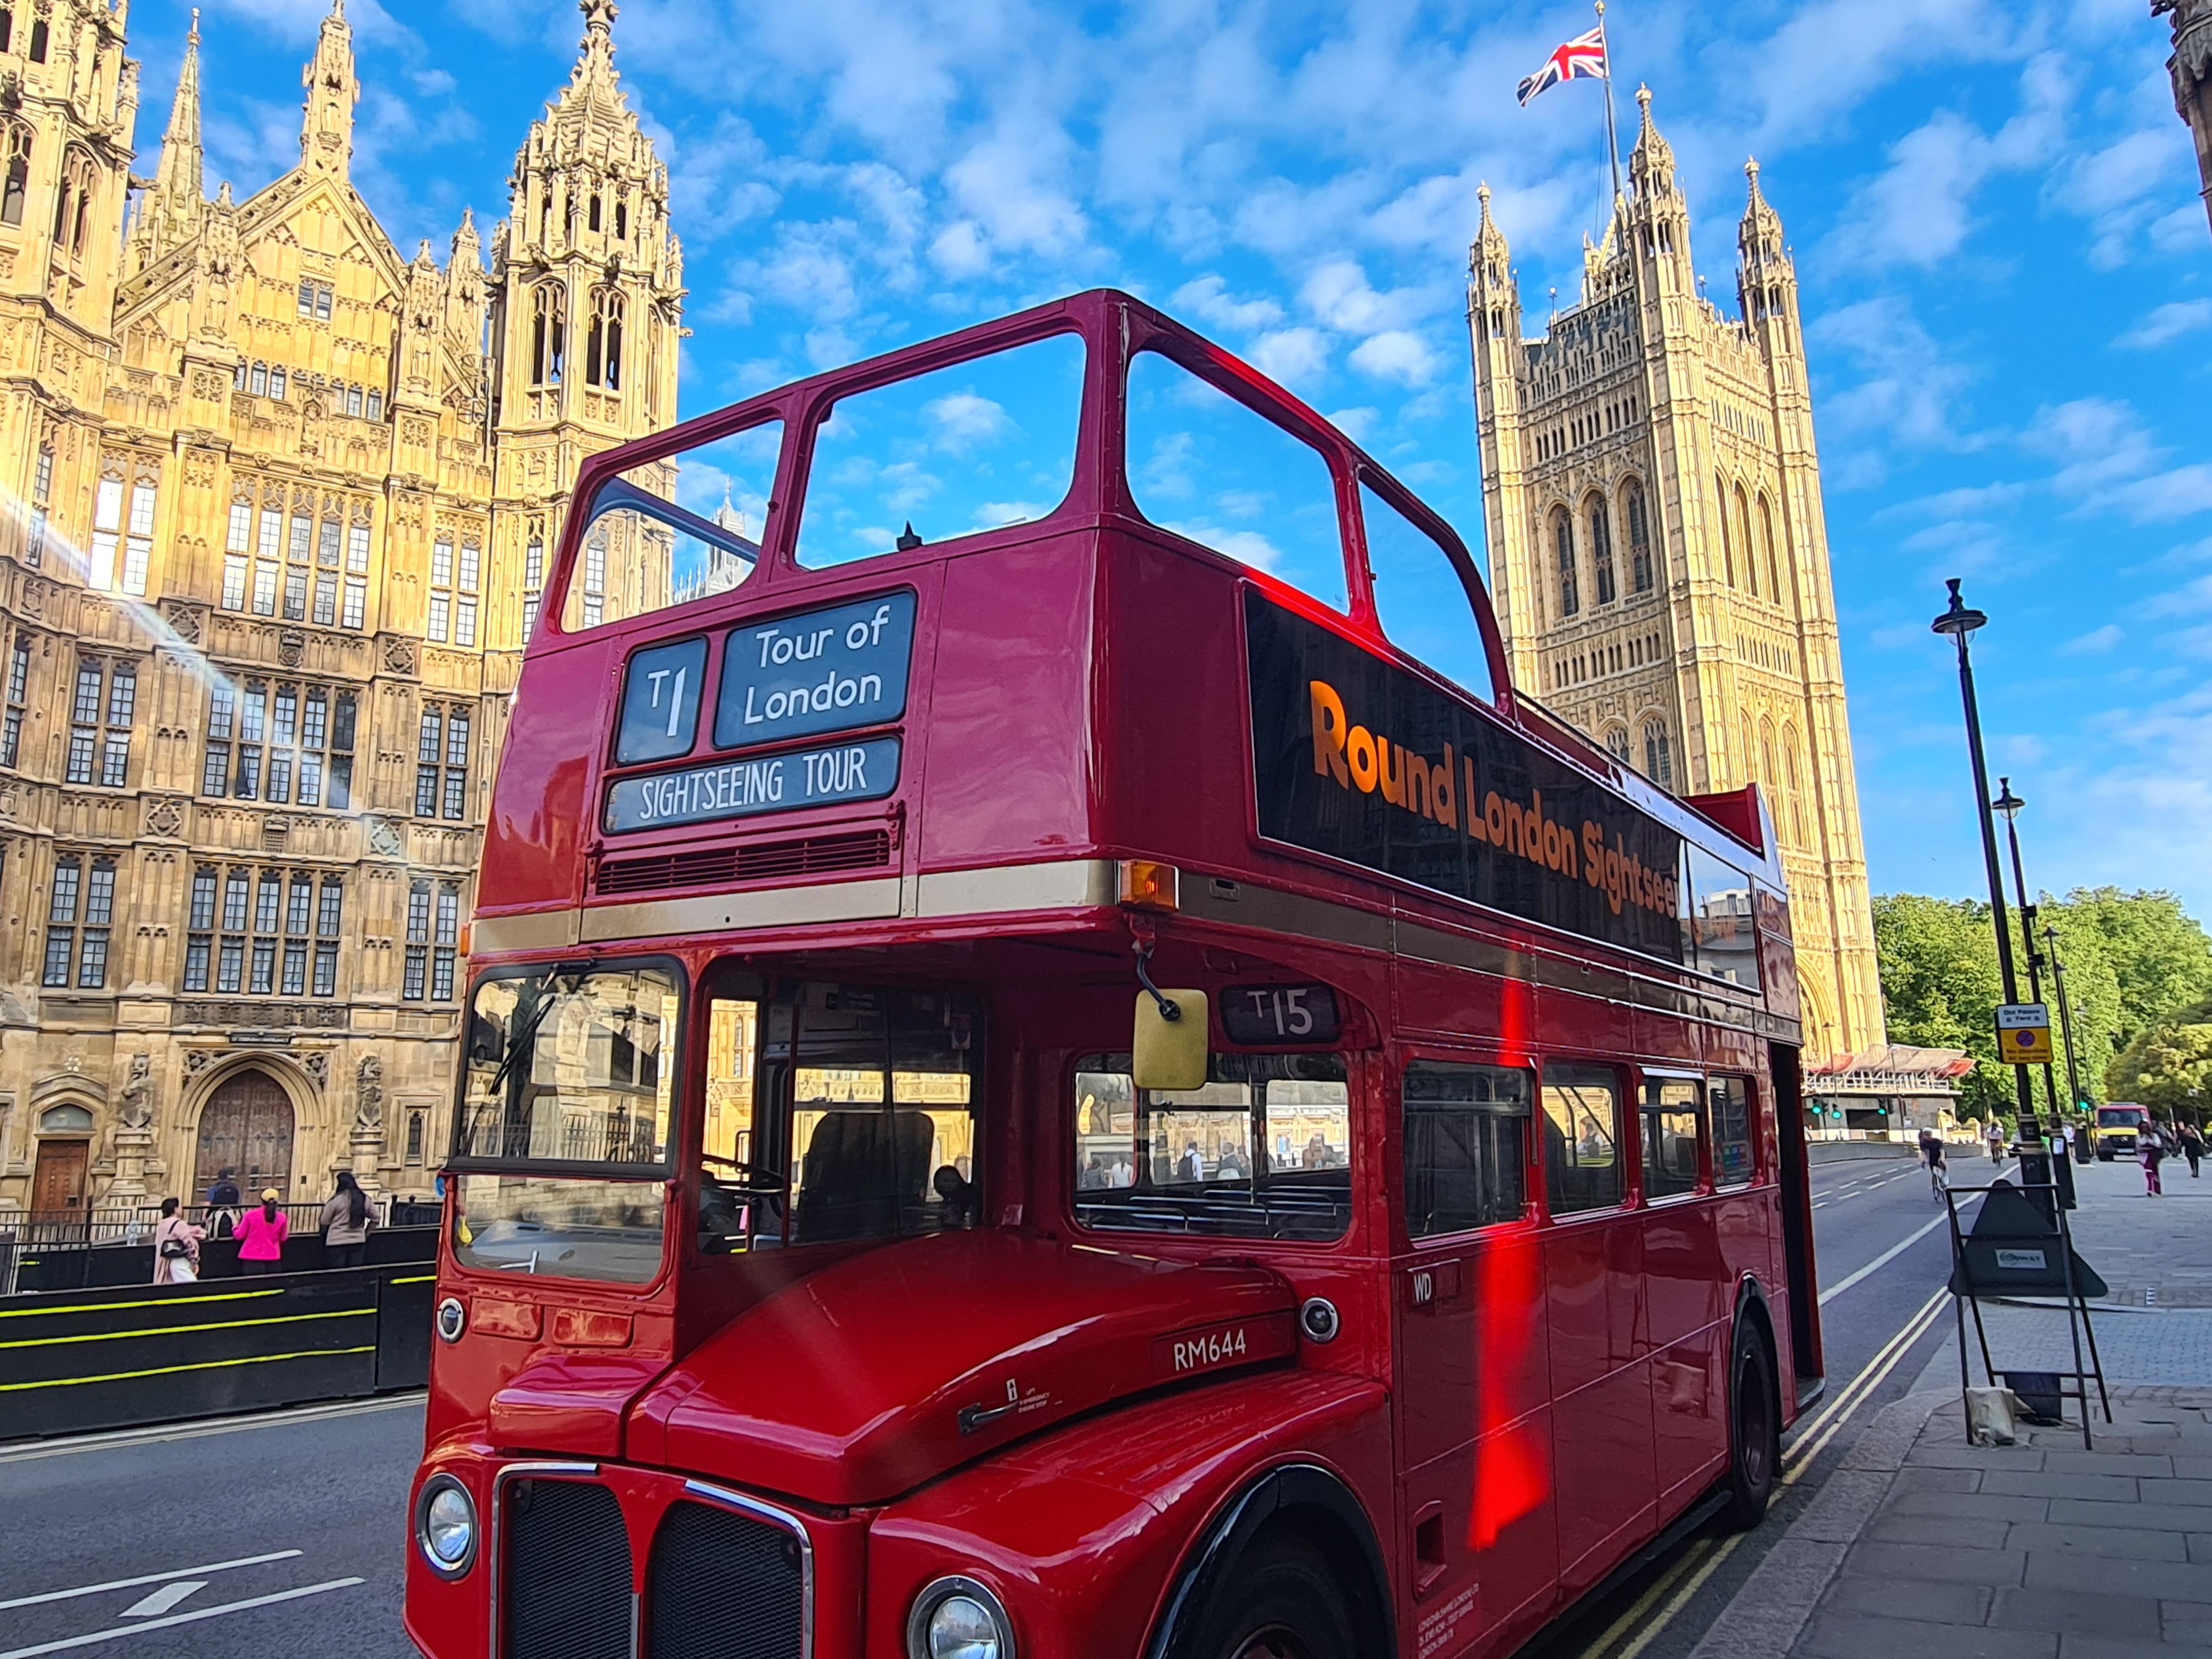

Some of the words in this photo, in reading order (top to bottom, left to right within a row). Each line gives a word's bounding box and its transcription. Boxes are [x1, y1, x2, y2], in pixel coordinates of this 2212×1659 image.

[755, 628, 834, 668] Tour
[845, 605, 890, 650] of
[647, 666, 686, 737] T1
[743, 670, 881, 725] London
[639, 761, 783, 820] SIGHTSEEING
[802, 747, 867, 797] TOUR
[1310, 680, 1457, 830] Round
[1464, 755, 1578, 879] London
[1246, 989, 1313, 1036] T15
[1413, 1272, 1432, 1303] WD
[1174, 1328, 1246, 1372] RM644
